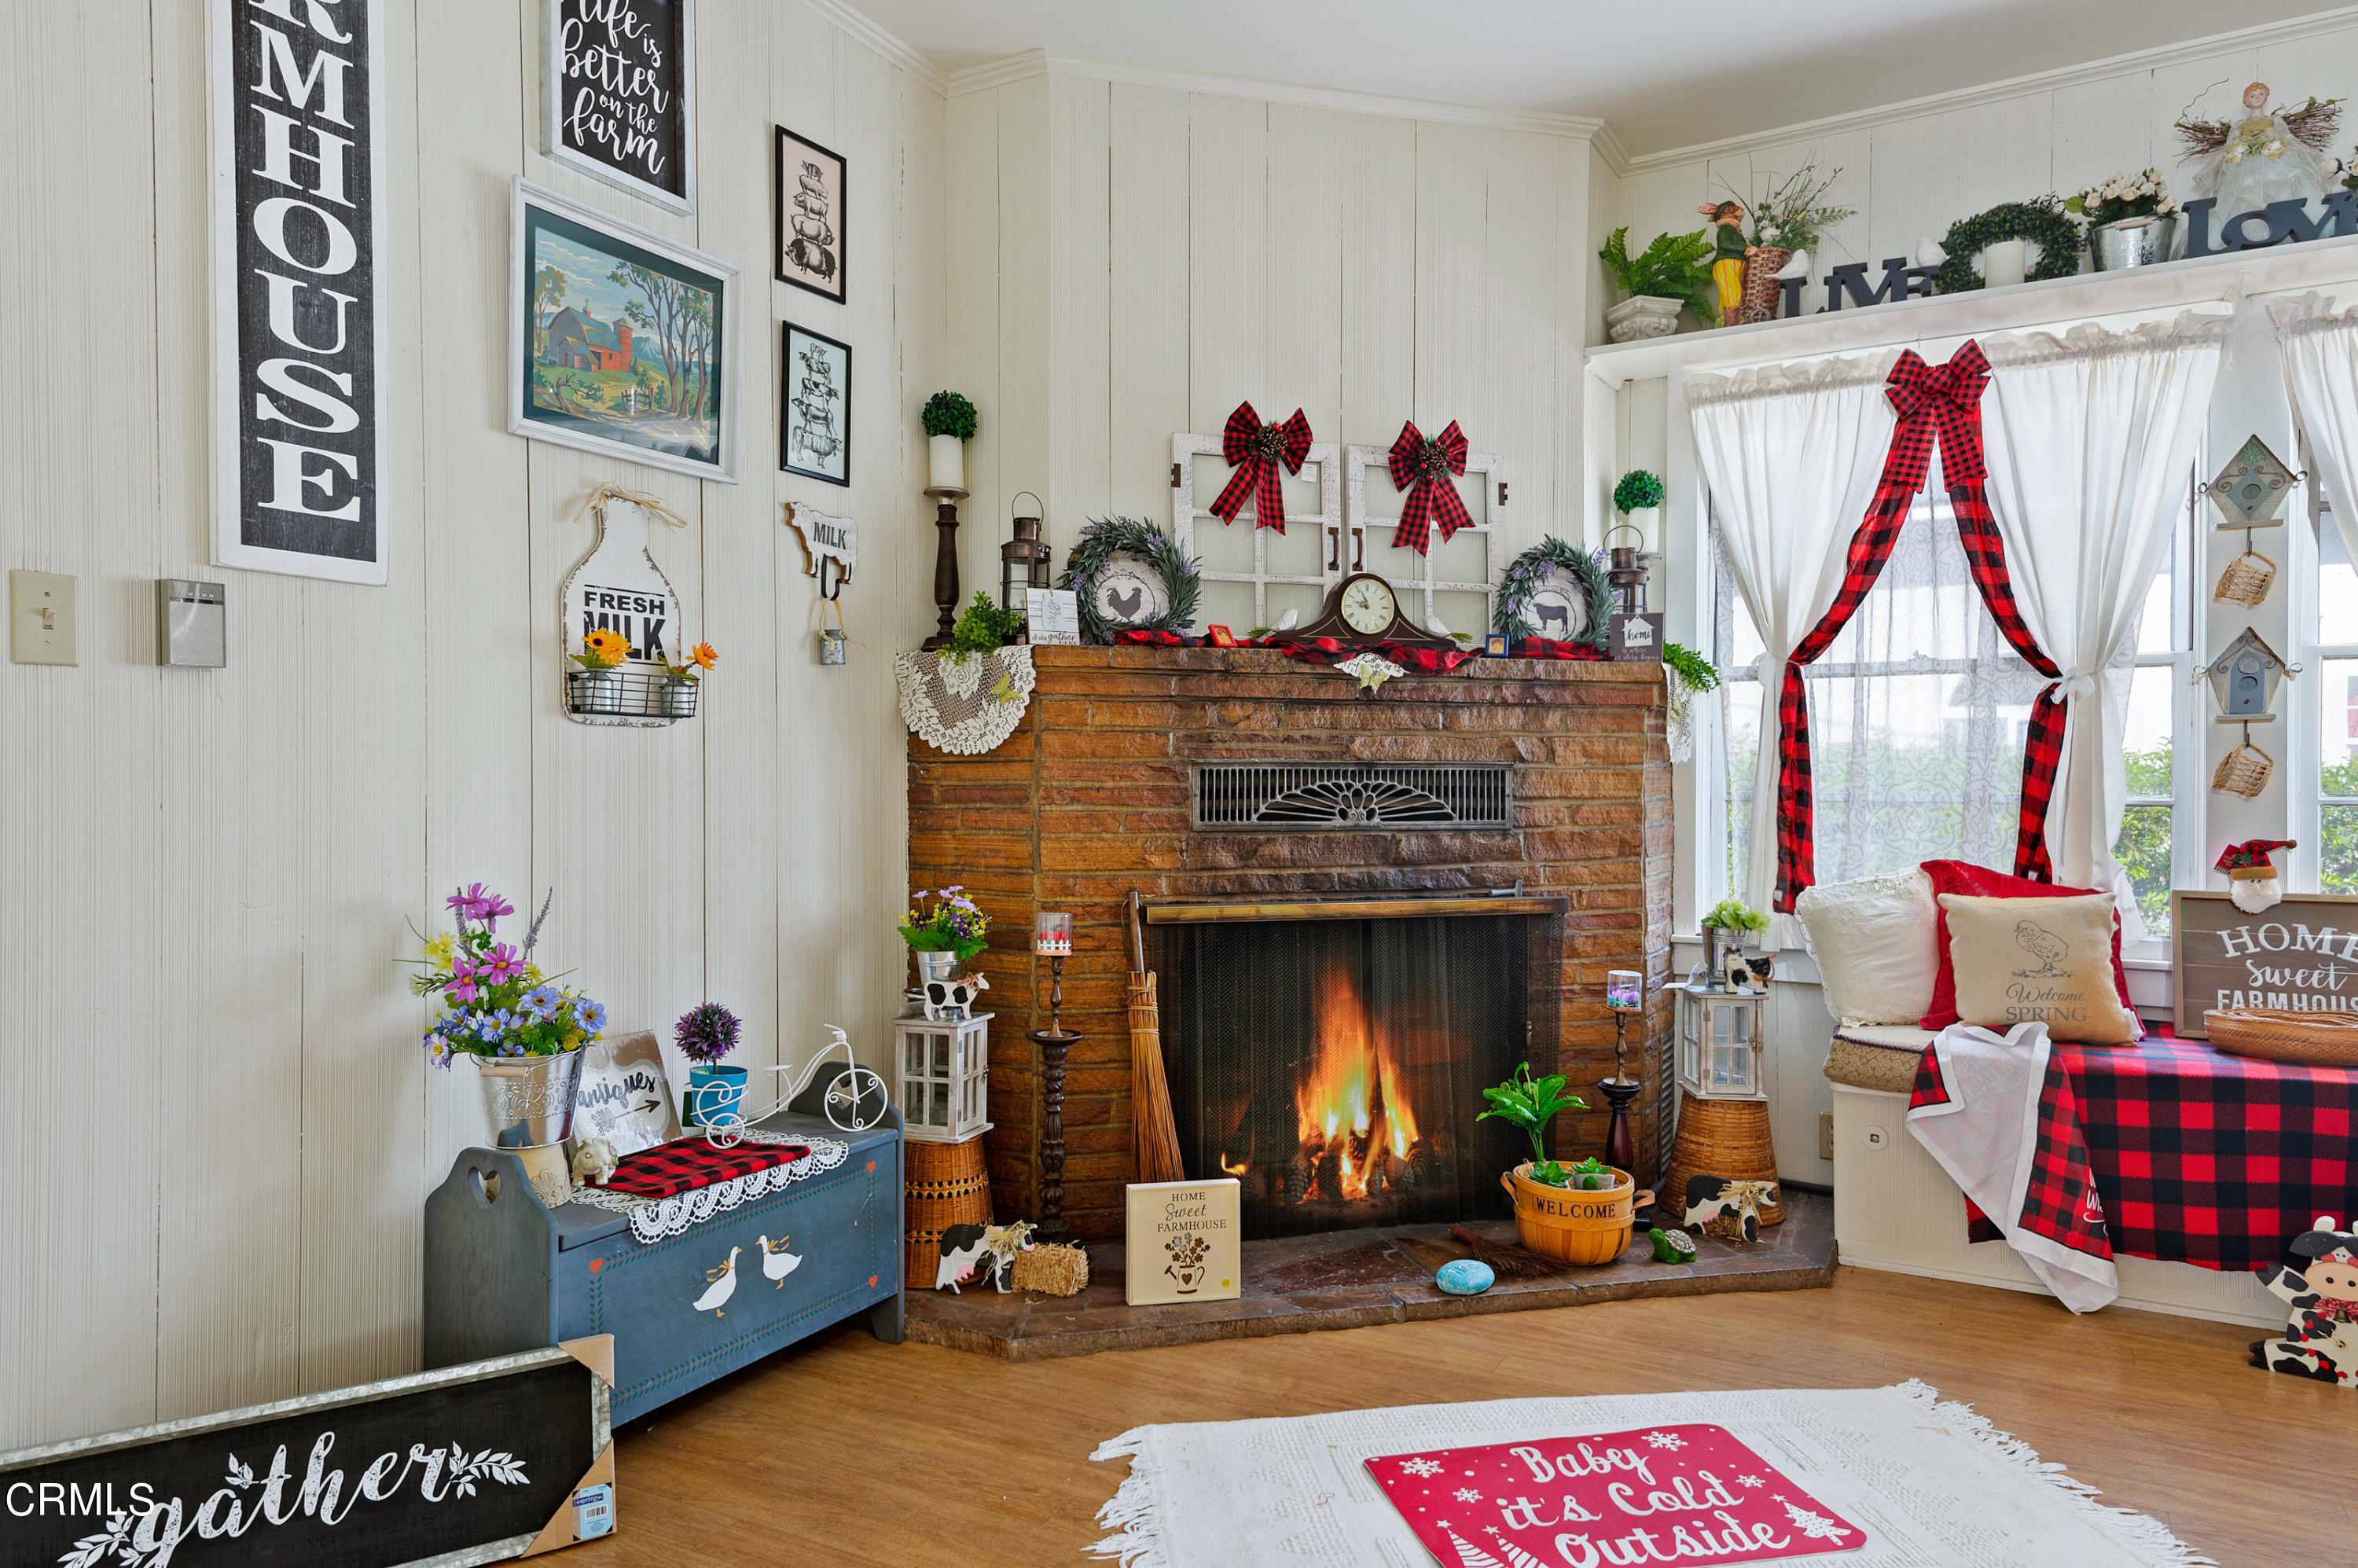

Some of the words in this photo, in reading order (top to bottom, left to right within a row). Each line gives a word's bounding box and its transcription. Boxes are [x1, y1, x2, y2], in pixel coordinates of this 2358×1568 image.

[643, 33, 663, 68] is
[560, 18, 669, 114] better
[599, 94, 624, 119] on
[625, 101, 658, 134] the
[563, 86, 666, 174] farm
[814, 521, 847, 550] MILK
[584, 590, 665, 615] FRESH
[1048, 631, 1076, 644] gather
[1626, 629, 1651, 641] home
[2006, 982, 2086, 1004] Welcome
[2217, 989, 2358, 1012] FARMHOU
[2006, 1006, 2087, 1022] SPRING
[1172, 1192, 1206, 1202] HOME
[1536, 1196, 1616, 1219] WELCOME
[1165, 1203, 1207, 1221] Sweet
[1157, 1219, 1227, 1233] FARMHOUSE
[1509, 1442, 1657, 1485] Baby
[132, 1430, 452, 1568] gather
[1496, 1495, 1602, 1530] it's
[1607, 1470, 1745, 1516] Cold
[1554, 1509, 1791, 1568] Outside
